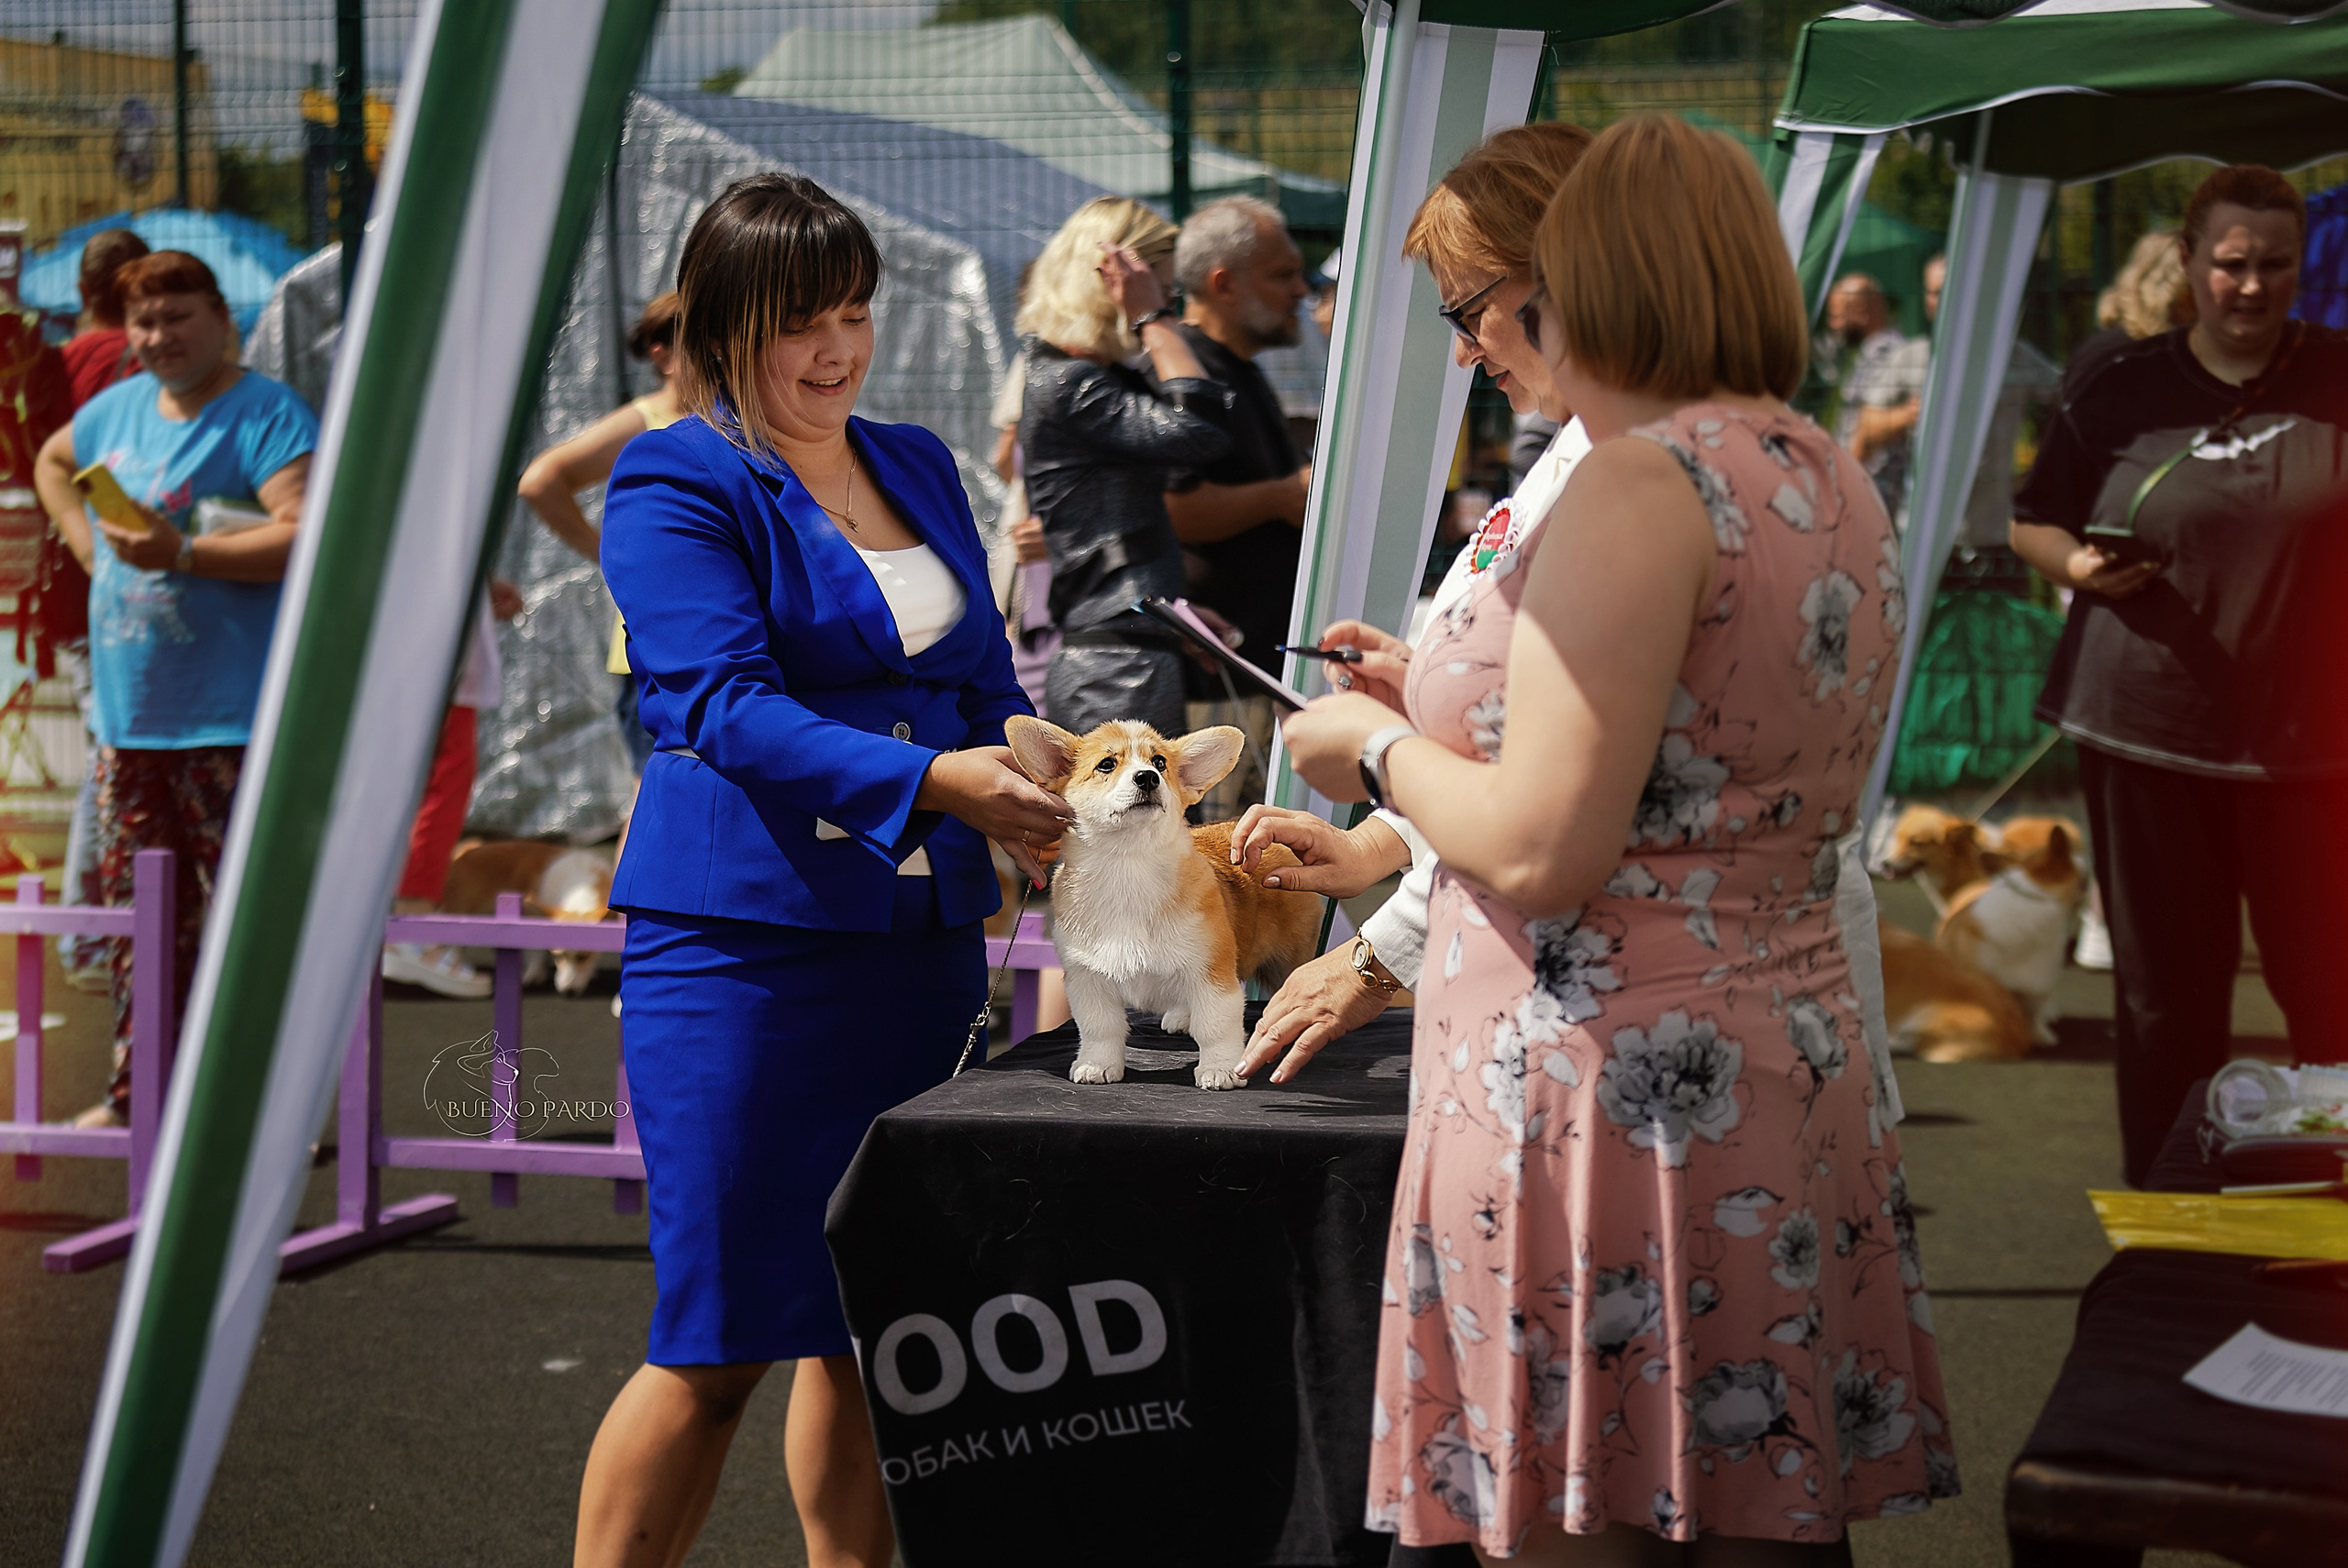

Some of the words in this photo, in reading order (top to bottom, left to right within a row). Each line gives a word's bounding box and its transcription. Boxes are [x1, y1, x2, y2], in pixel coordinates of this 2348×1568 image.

[851, 1279, 1168, 1415] OOD
[878, 1430, 995, 1485] ОБАК
[1002, 1426, 1032, 1456] И
[1042, 1399, 1192, 1449] КОШЕК
